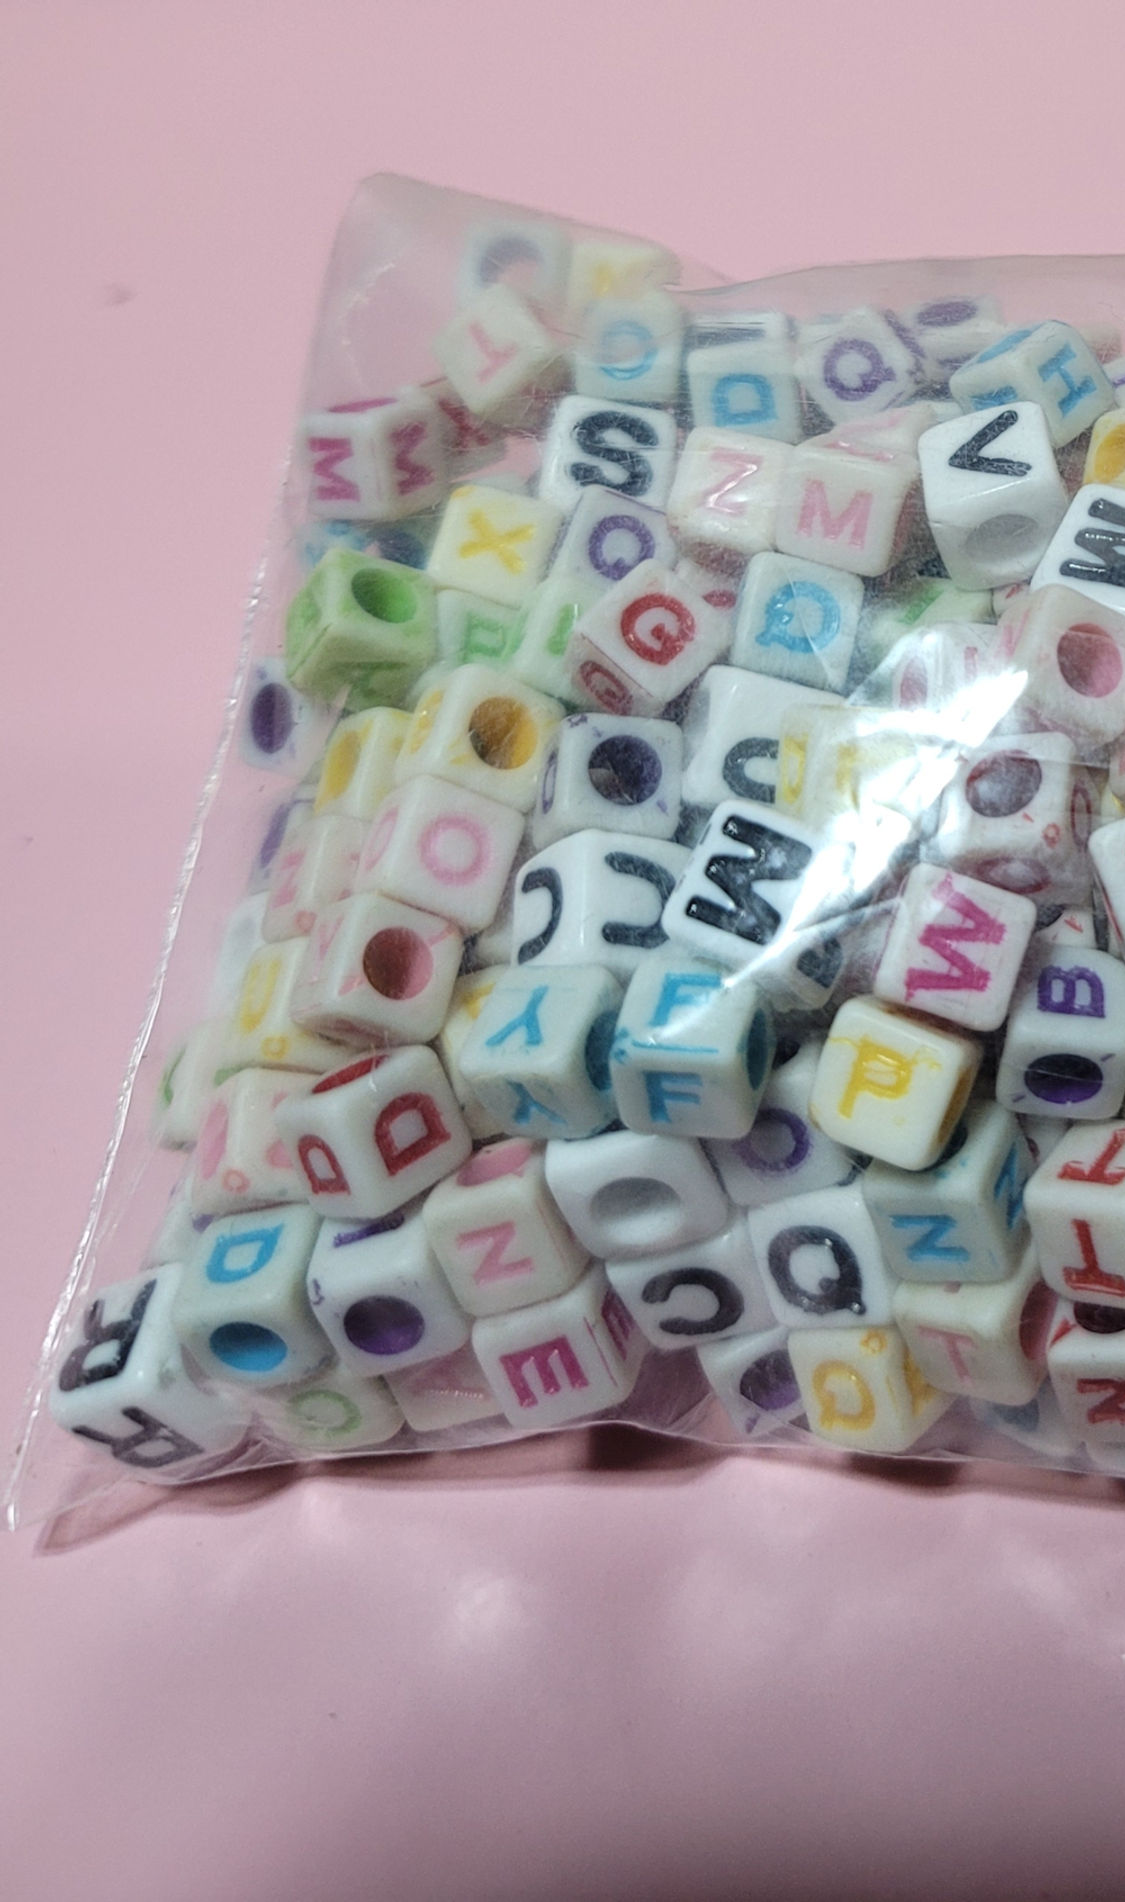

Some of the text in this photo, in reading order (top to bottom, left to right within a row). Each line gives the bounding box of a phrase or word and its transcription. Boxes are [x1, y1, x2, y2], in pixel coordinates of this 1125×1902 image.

[711, 373, 778, 428] D
[822, 338, 895, 400] Q
[570, 411, 659, 497] S
[948, 410, 1032, 476] V
[459, 508, 534, 576] X
[756, 581, 841, 654] Q
[419, 813, 490, 885] O
[487, 986, 549, 1046] Y
[649, 972, 722, 1027] F
[1037, 965, 1105, 1019] B
[642, 1071, 703, 1124] F
[838, 1036, 916, 1120] P
[299, 1134, 351, 1195] D
[374, 1092, 451, 1175] D
[206, 1224, 284, 1283] D
[767, 1225, 866, 1315] Q
[642, 1267, 744, 1335] C
